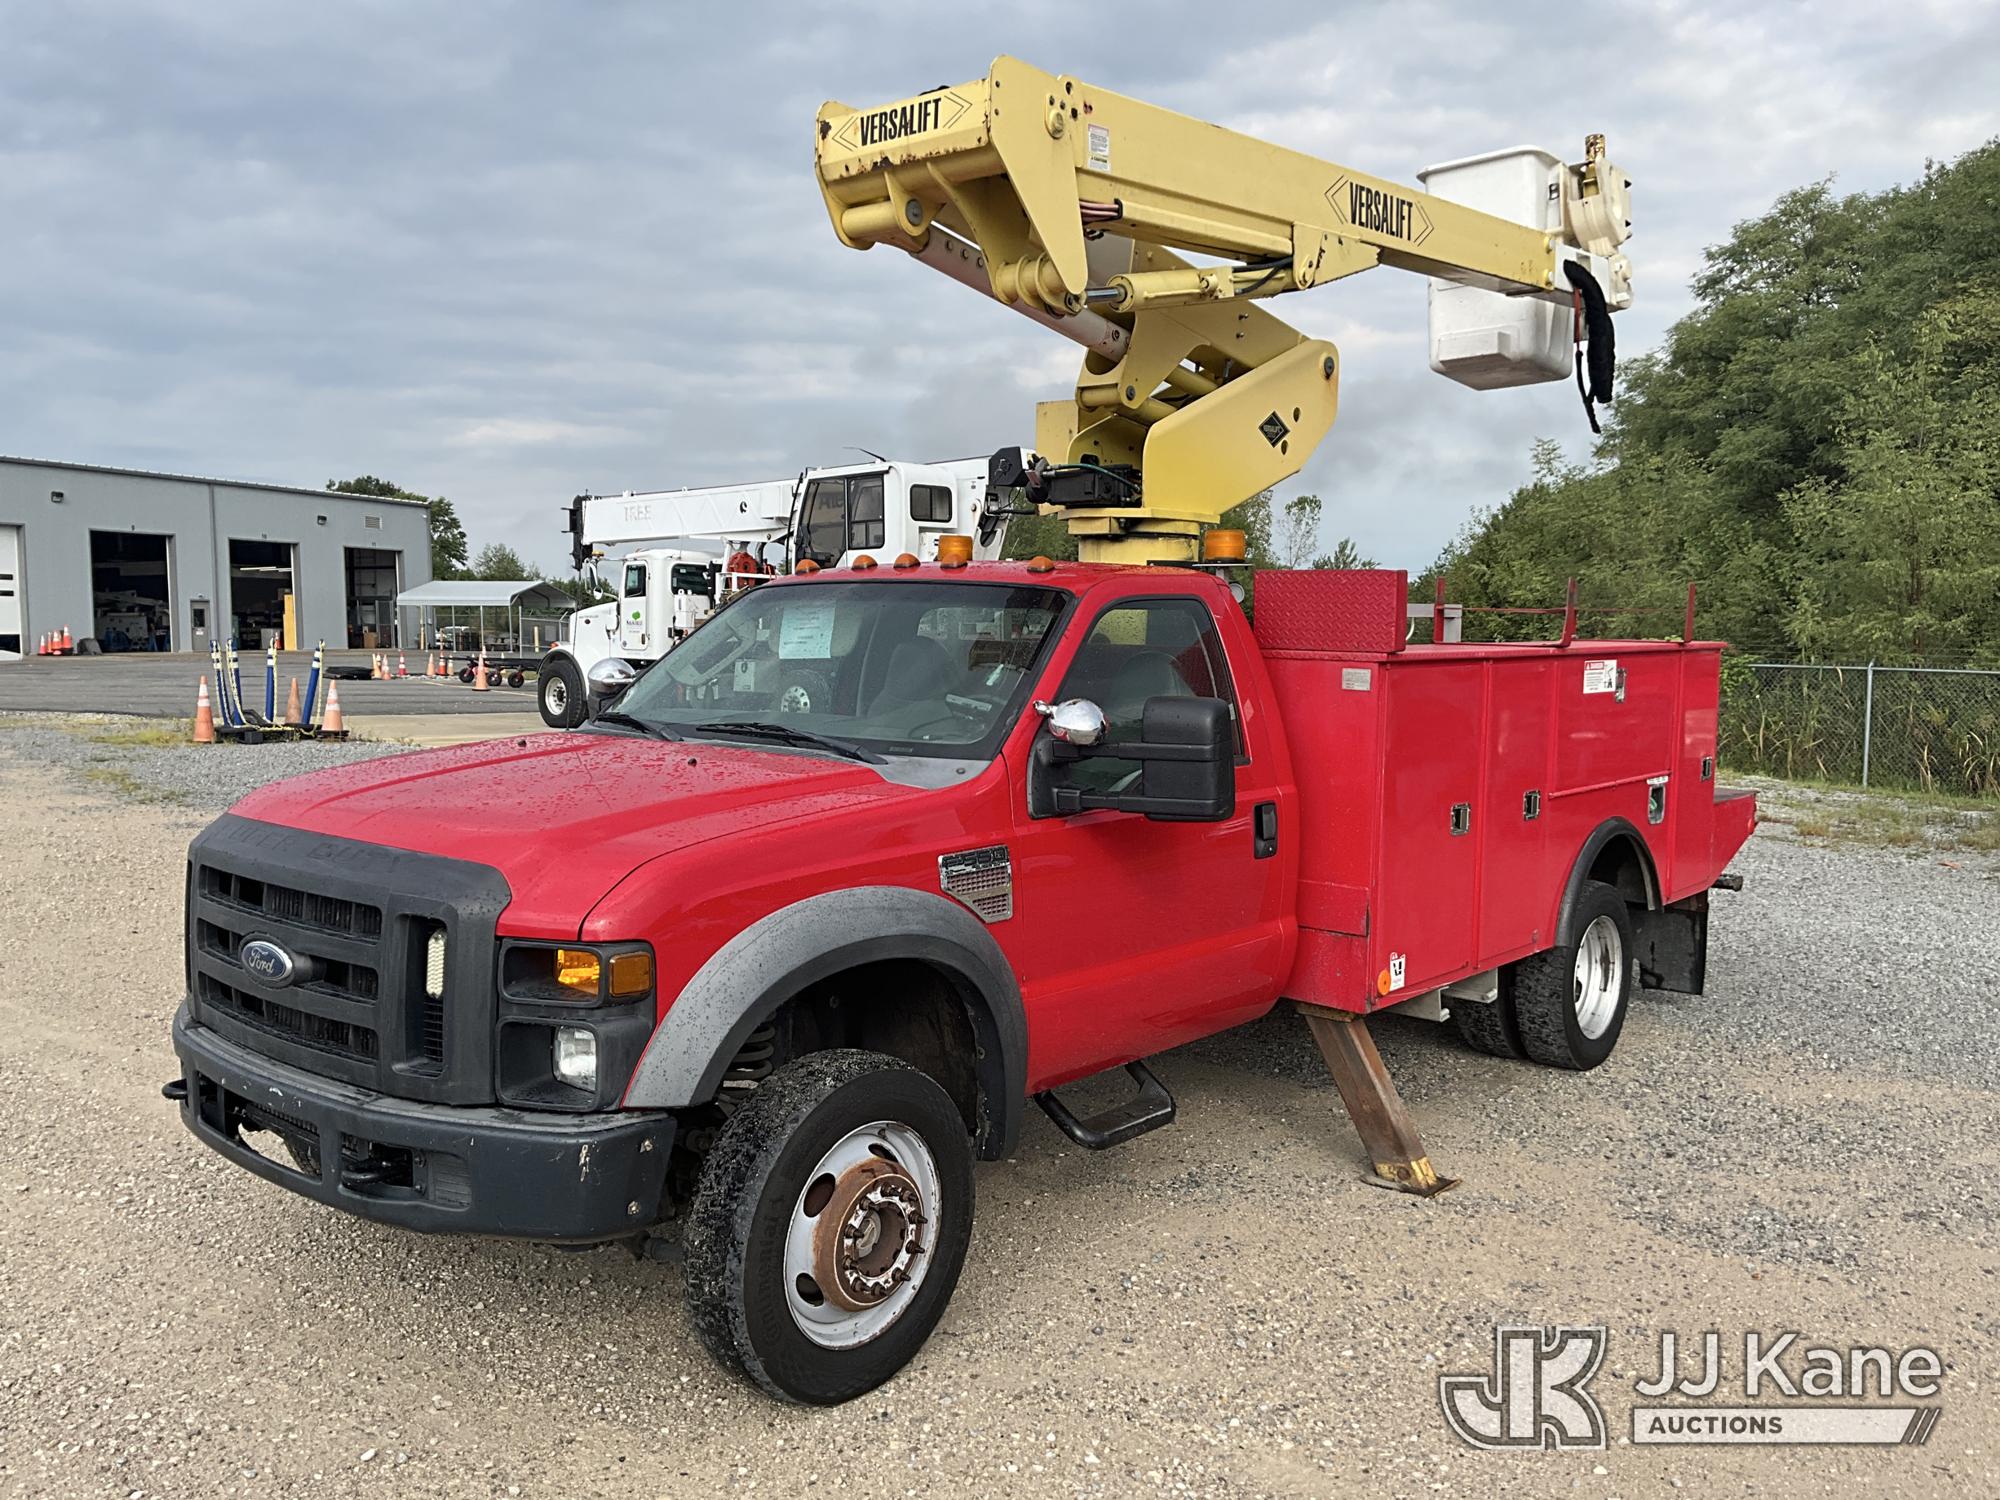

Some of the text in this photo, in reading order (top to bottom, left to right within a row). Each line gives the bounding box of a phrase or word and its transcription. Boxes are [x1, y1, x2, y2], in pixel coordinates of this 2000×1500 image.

[860, 97, 942, 147] VERSALIFT
[1349, 181, 1413, 242] VERSALIFT
[248, 946, 276, 974] Ford
